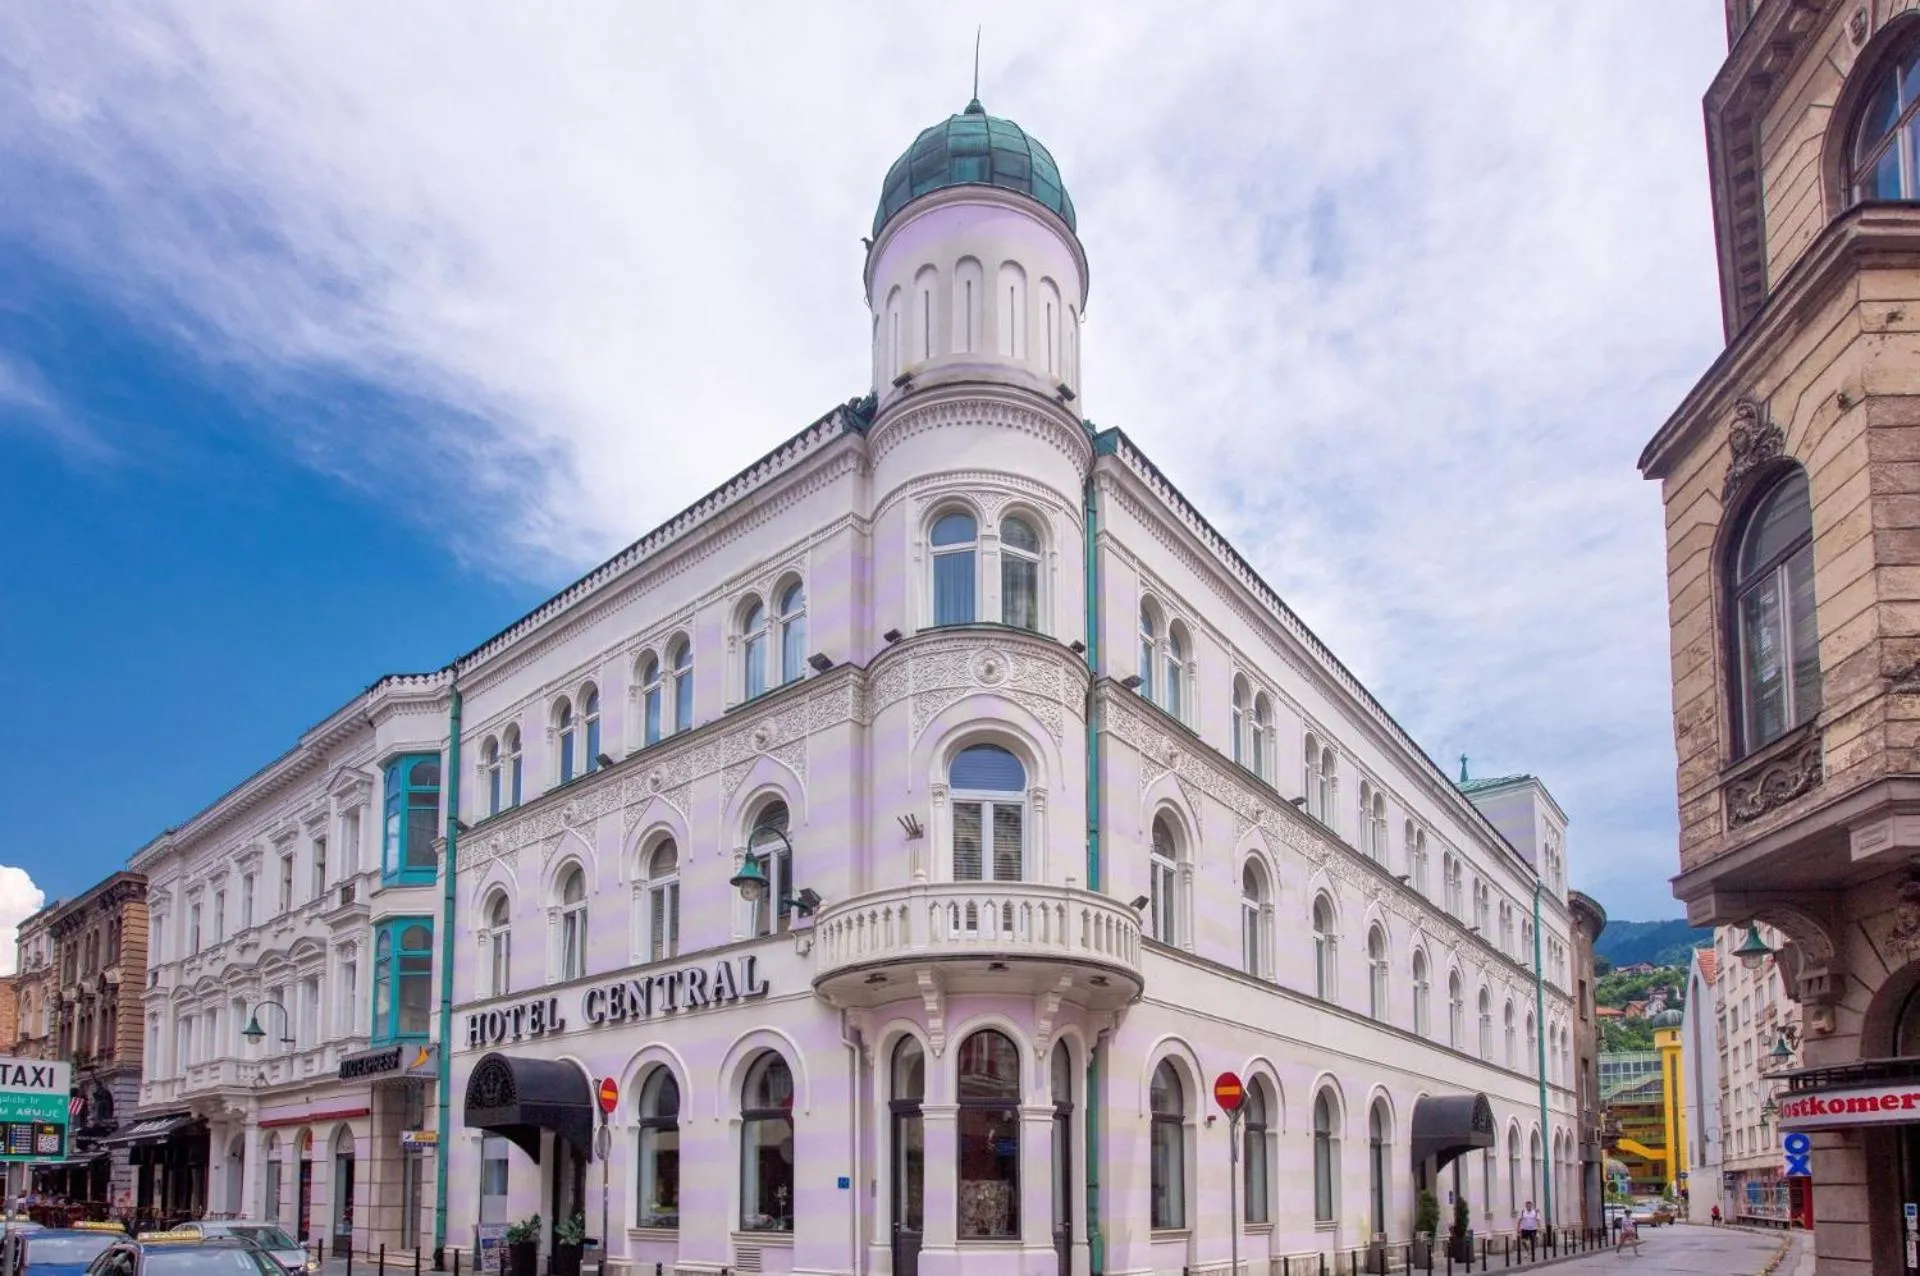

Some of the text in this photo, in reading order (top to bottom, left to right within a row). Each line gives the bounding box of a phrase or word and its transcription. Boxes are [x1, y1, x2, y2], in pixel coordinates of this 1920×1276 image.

[464, 954, 770, 1046] HOTEL CENTRAL
[0, 1064, 54, 1088] TAXI
